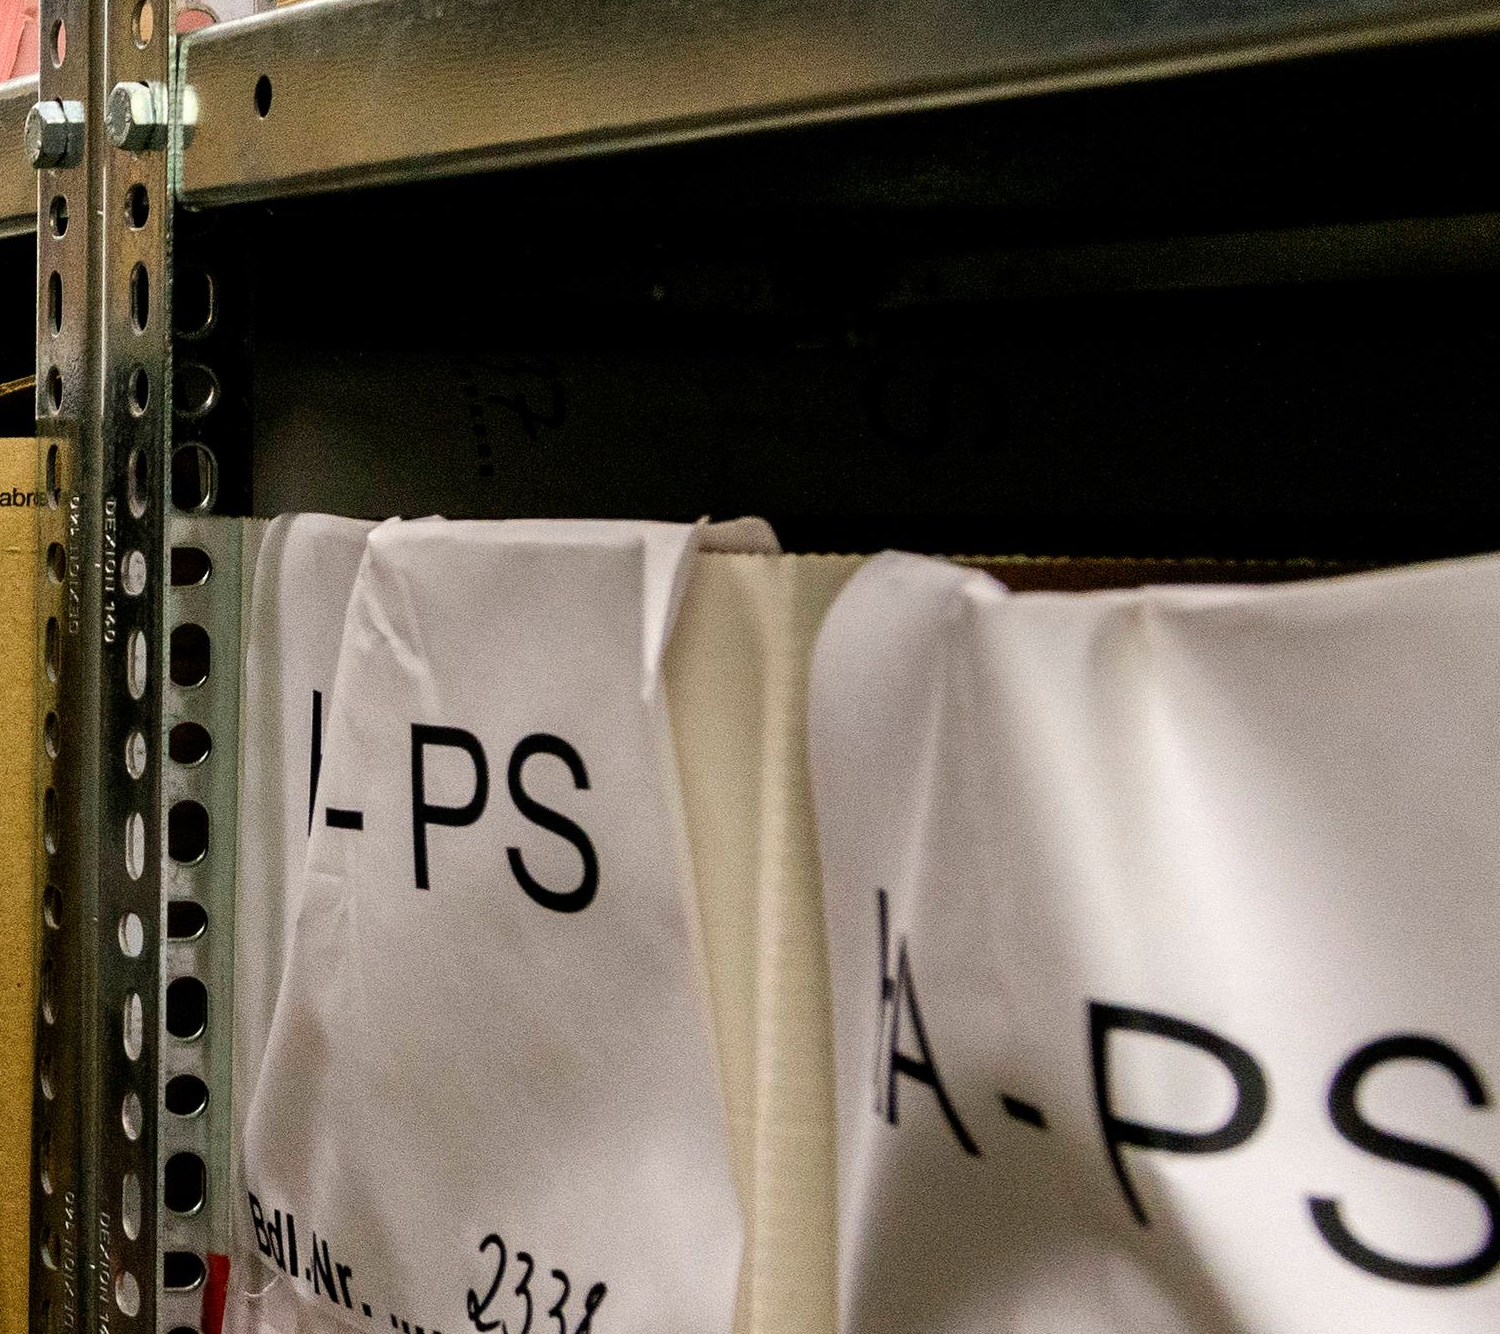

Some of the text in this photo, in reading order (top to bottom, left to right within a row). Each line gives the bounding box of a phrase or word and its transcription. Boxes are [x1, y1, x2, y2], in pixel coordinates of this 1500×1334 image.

[69, 546, 80, 634] DEXION
[104, 499, 116, 644] DEXION 140
[99, 1211, 111, 1304] DEXION
